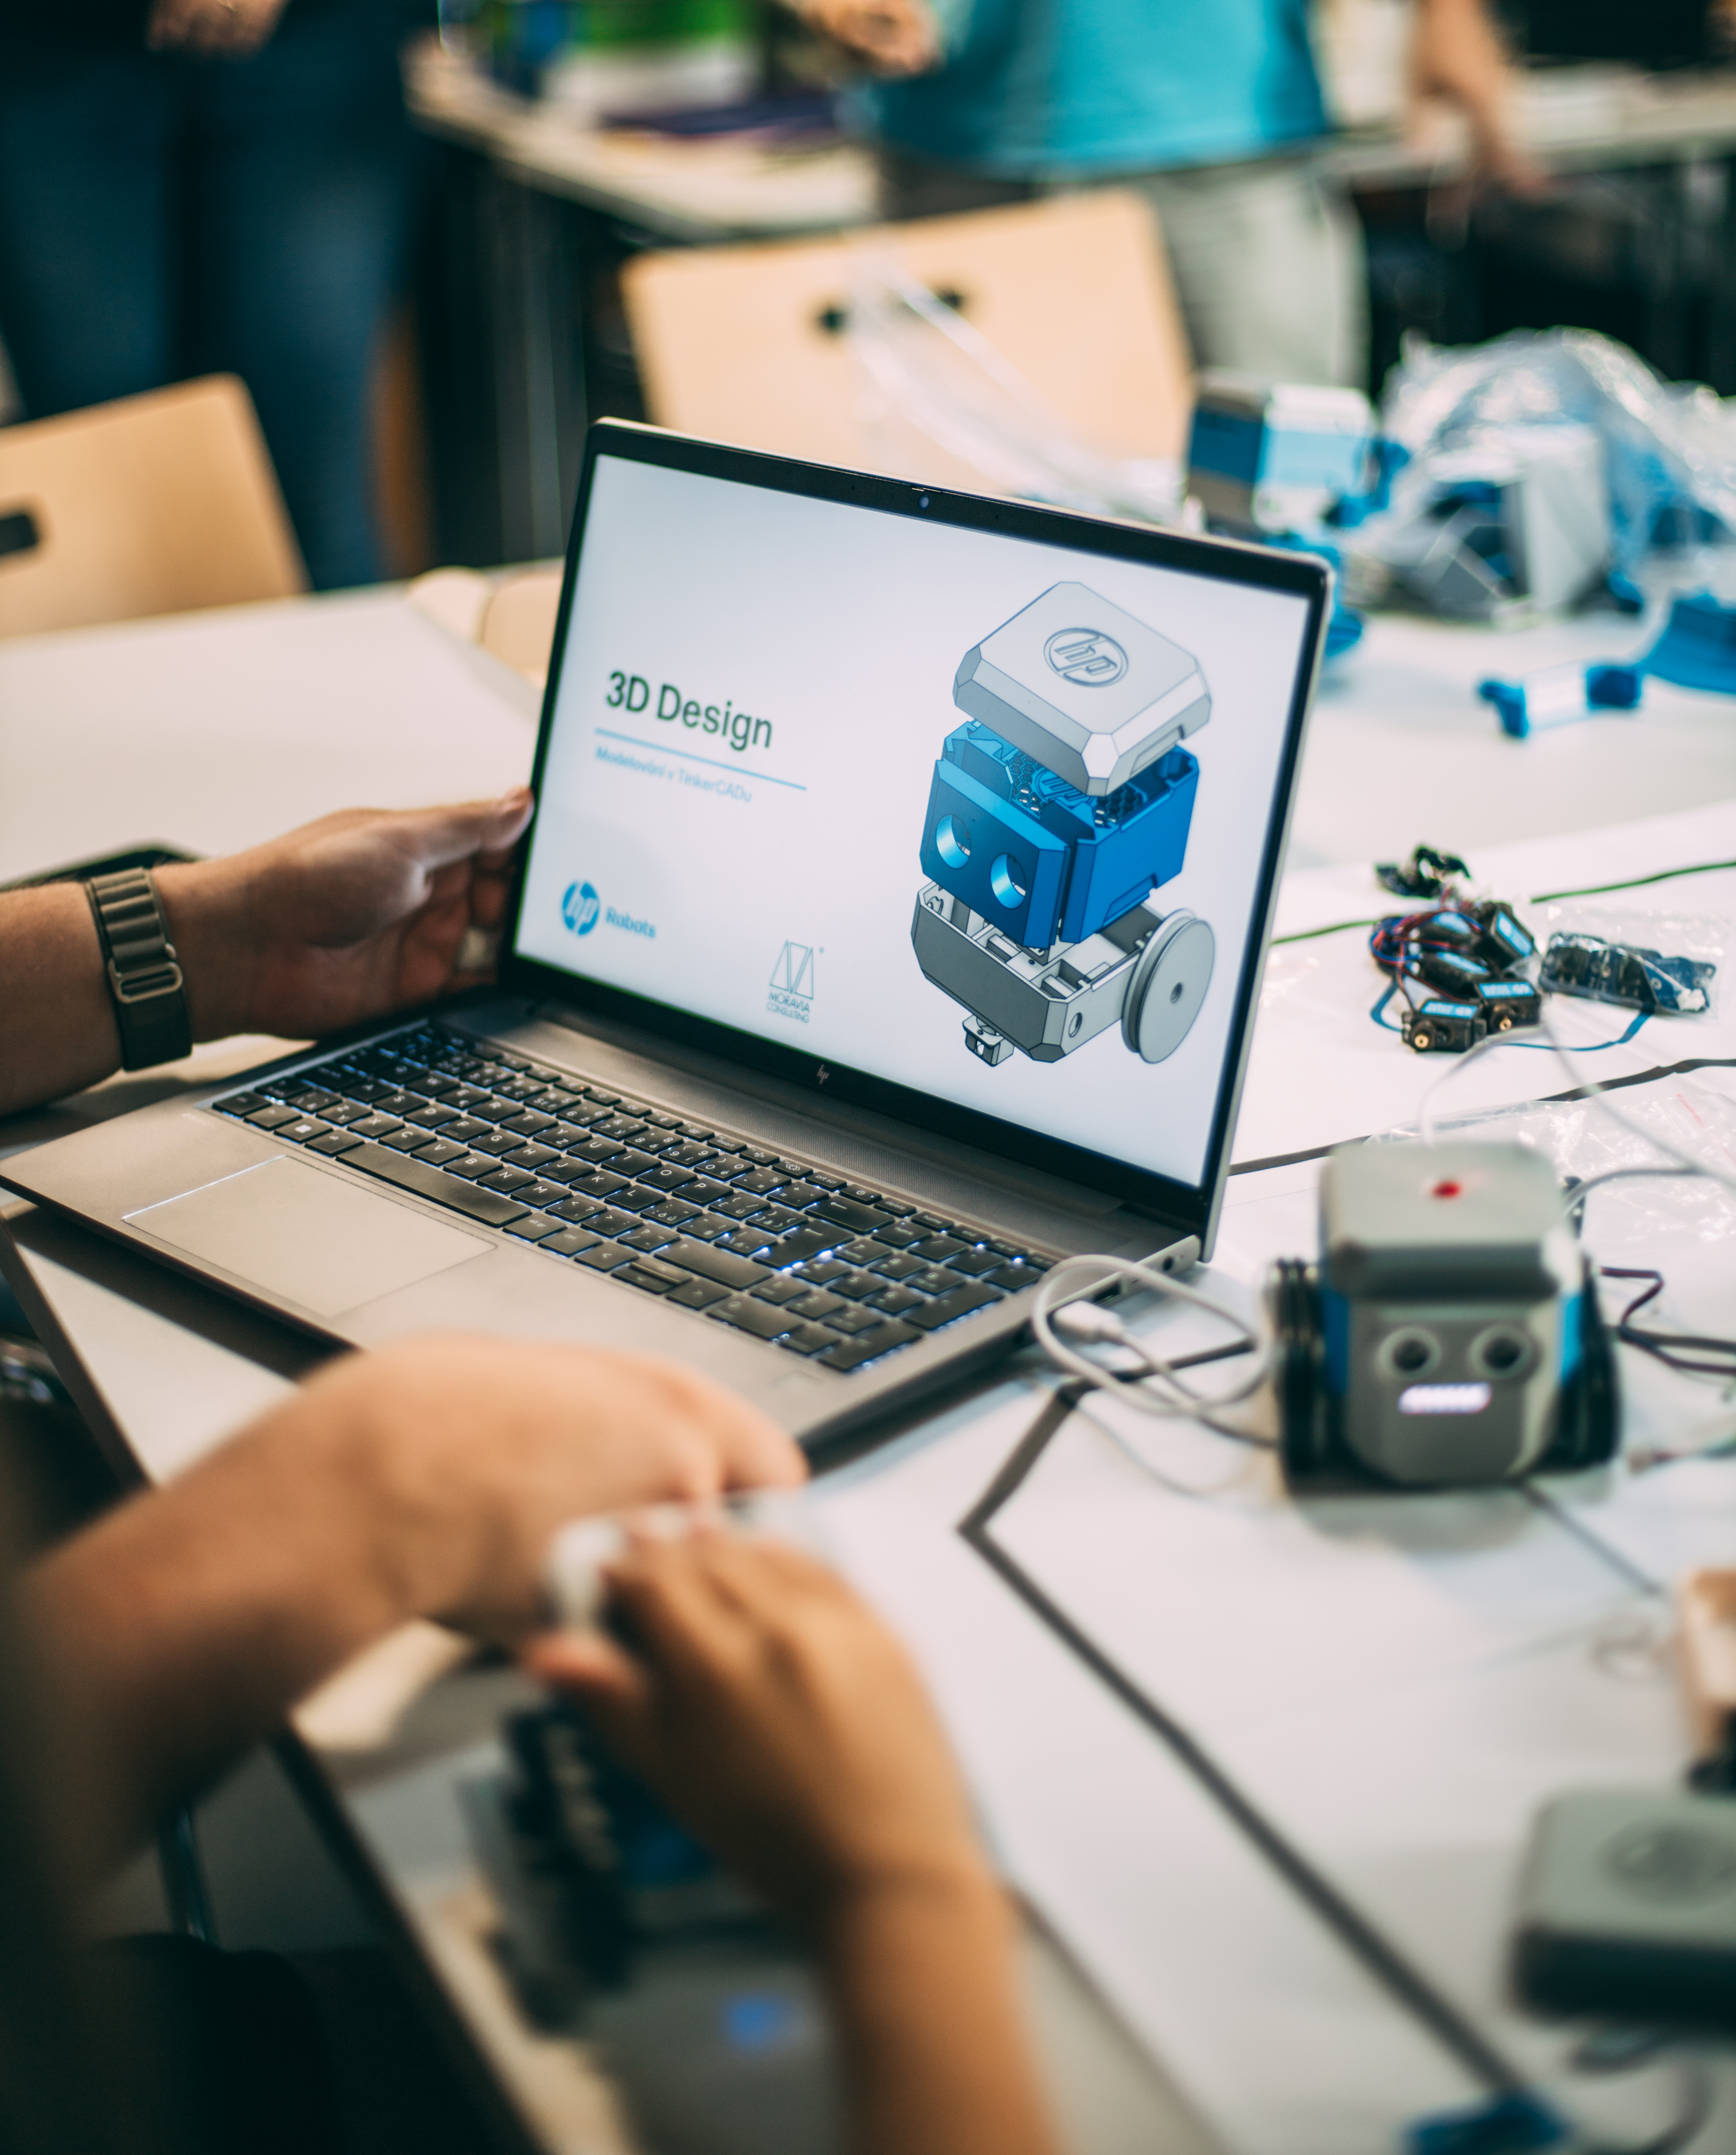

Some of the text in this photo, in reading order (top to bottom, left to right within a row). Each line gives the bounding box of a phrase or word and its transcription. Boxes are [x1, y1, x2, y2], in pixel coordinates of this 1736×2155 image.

[606, 670, 772, 751] 3D Design
[668, 770, 674, 780] v
[678, 768, 752, 803] TinkerCADu
[562, 879, 657, 939] hp Robots
[767, 1002, 810, 1023] CONSULTING
[768, 991, 810, 1013] MORAVIA
[716, 1139, 735, 1148] insert
[885, 1200, 907, 1210] delete
[922, 1214, 943, 1224] home
